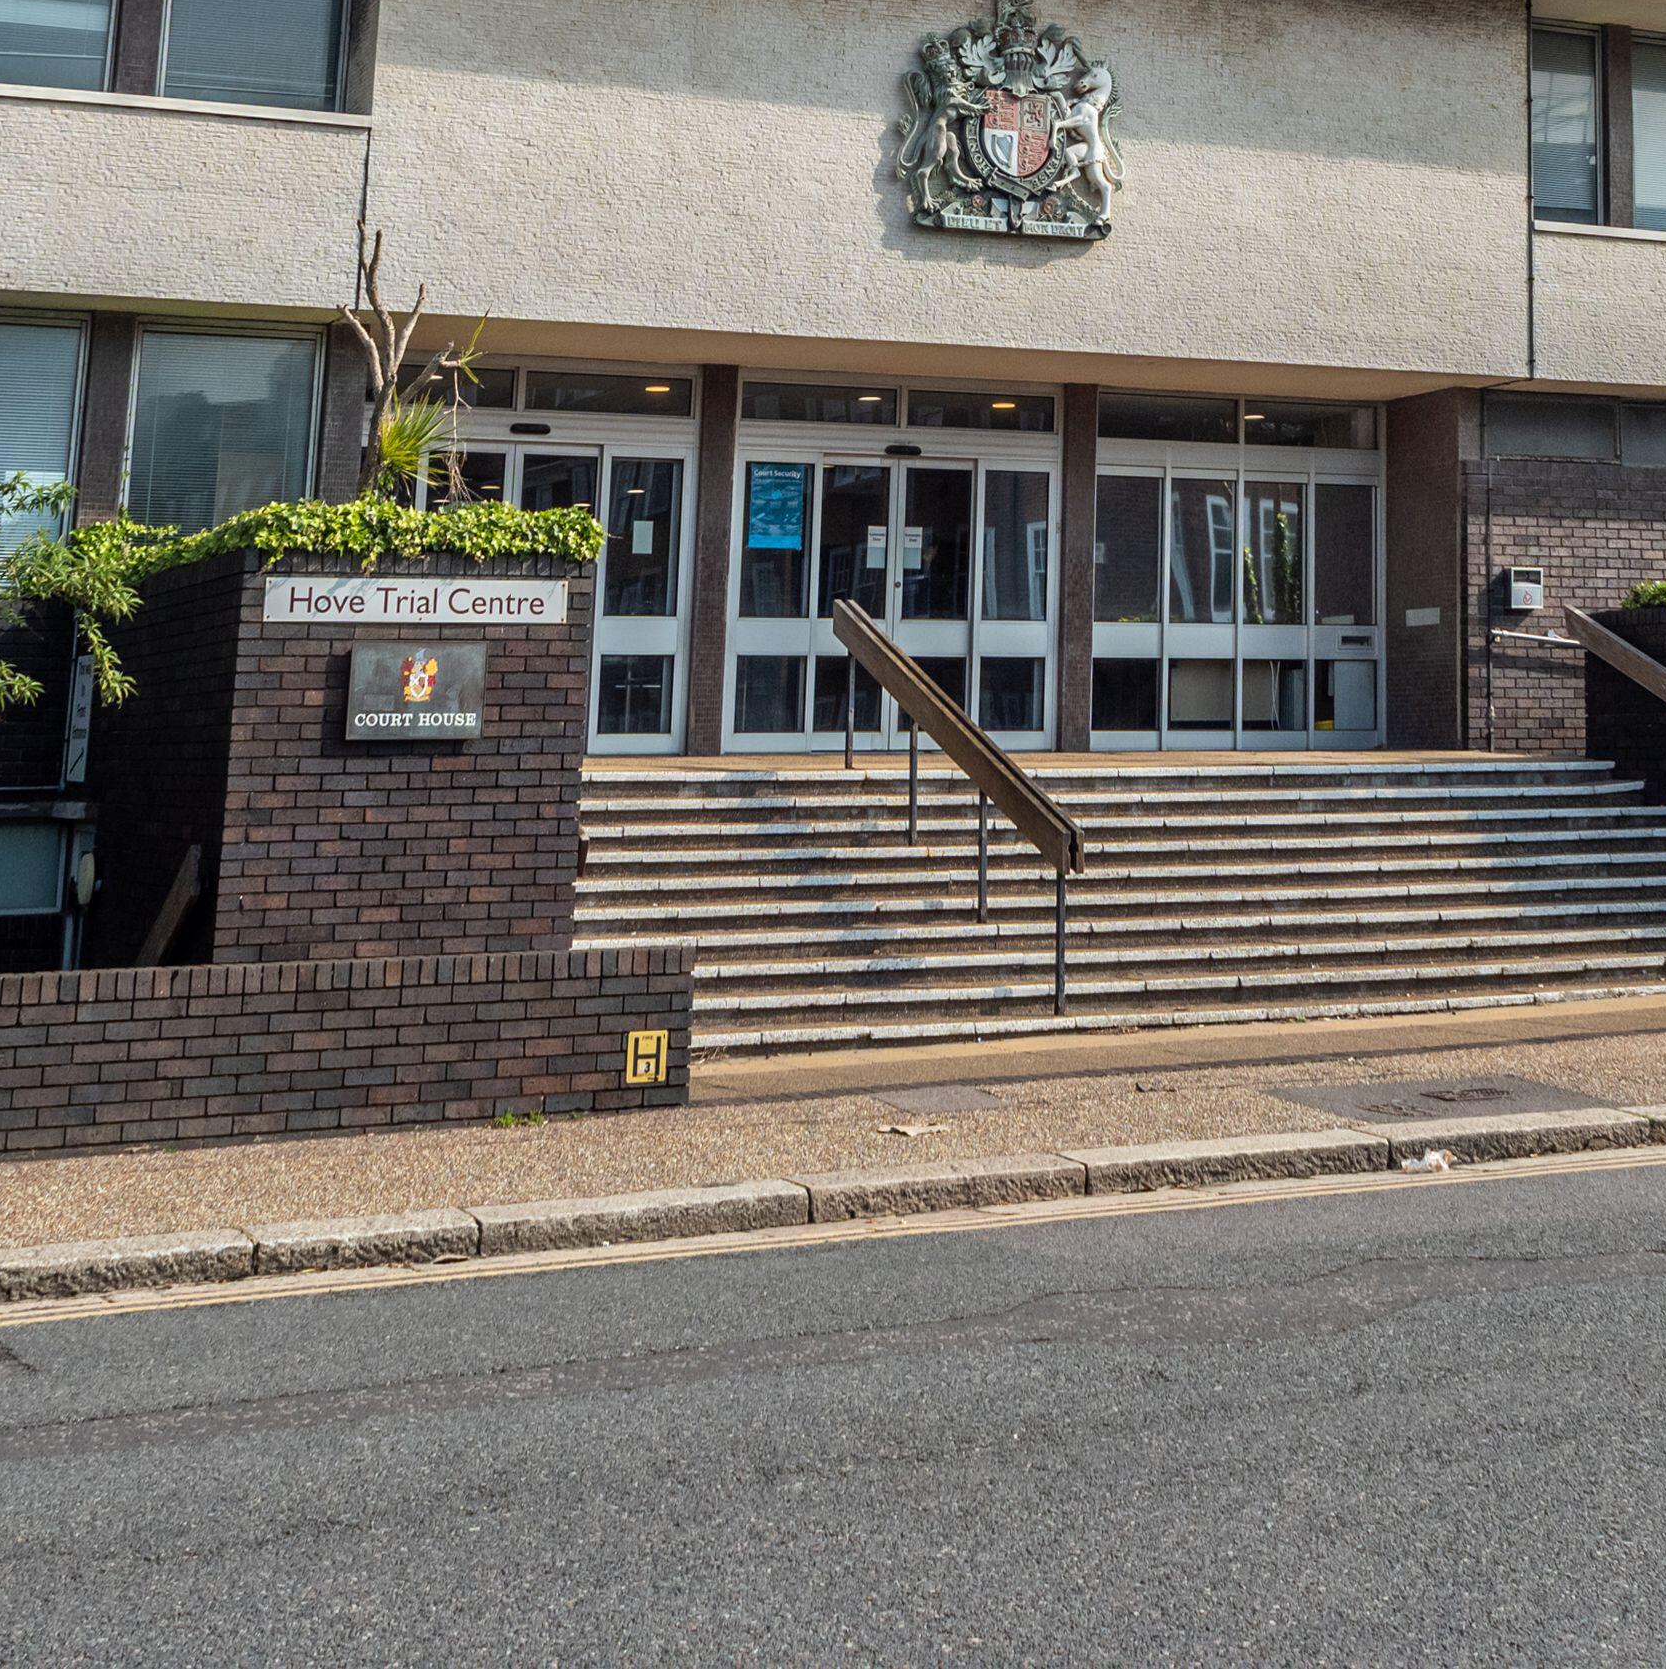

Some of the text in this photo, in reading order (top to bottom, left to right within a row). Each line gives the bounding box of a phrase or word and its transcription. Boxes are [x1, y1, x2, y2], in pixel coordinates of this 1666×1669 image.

[947, 216, 979, 229] DIEU
[984, 218, 1002, 230] ET
[754, 469, 801, 479] Court Security
[289, 587, 544, 616] Hove Trial Centre
[354, 713, 477, 727] COURT HOUSE
[633, 1036, 661, 1077] H
